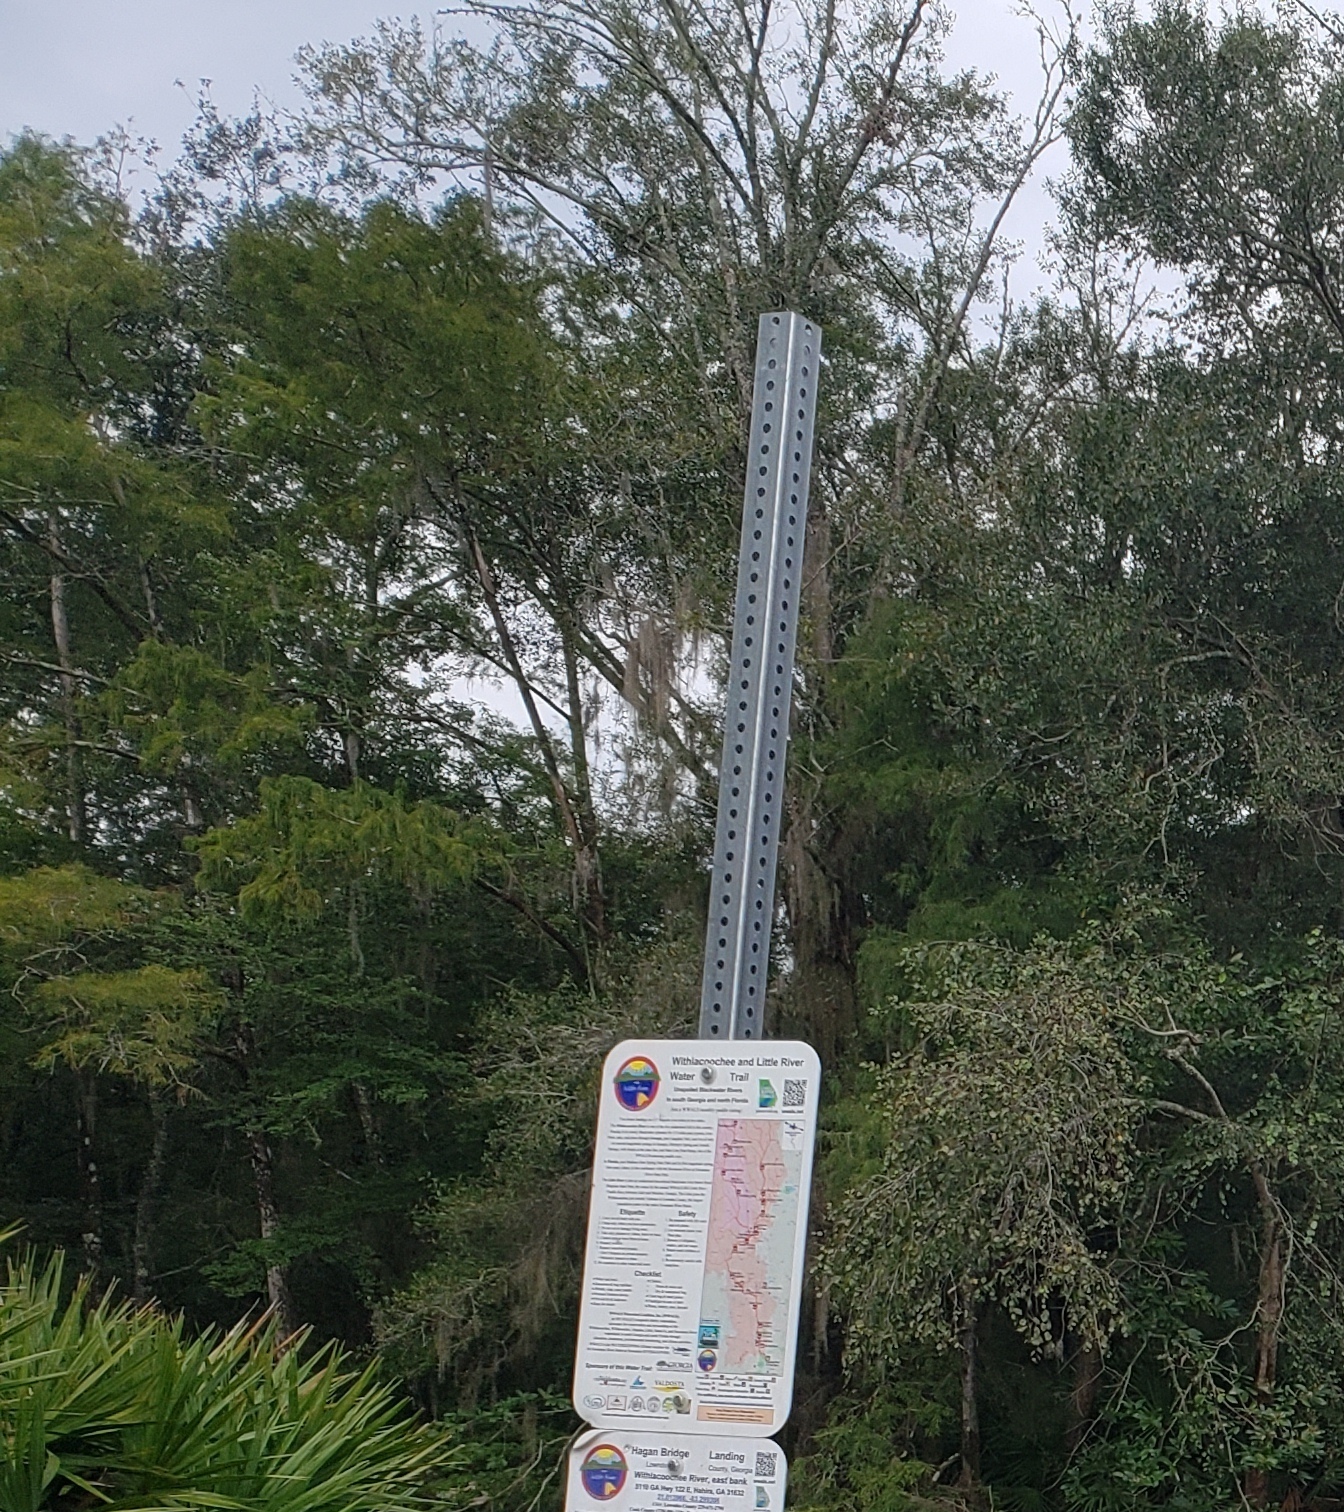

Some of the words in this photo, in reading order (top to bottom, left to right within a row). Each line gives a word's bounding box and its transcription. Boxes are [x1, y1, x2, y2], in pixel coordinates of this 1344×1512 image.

[738, 1057, 754, 1066] and
[756, 1057, 778, 1067] Little
[781, 1058, 805, 1067] River
[670, 1072, 696, 1081] Water
[730, 1072, 750, 1082] Trail
[631, 1446, 658, 1458] Hagan
[660, 1448, 690, 1459] Bridge
[709, 1450, 745, 1463] Landing
[689, 1474, 710, 1484] River,
